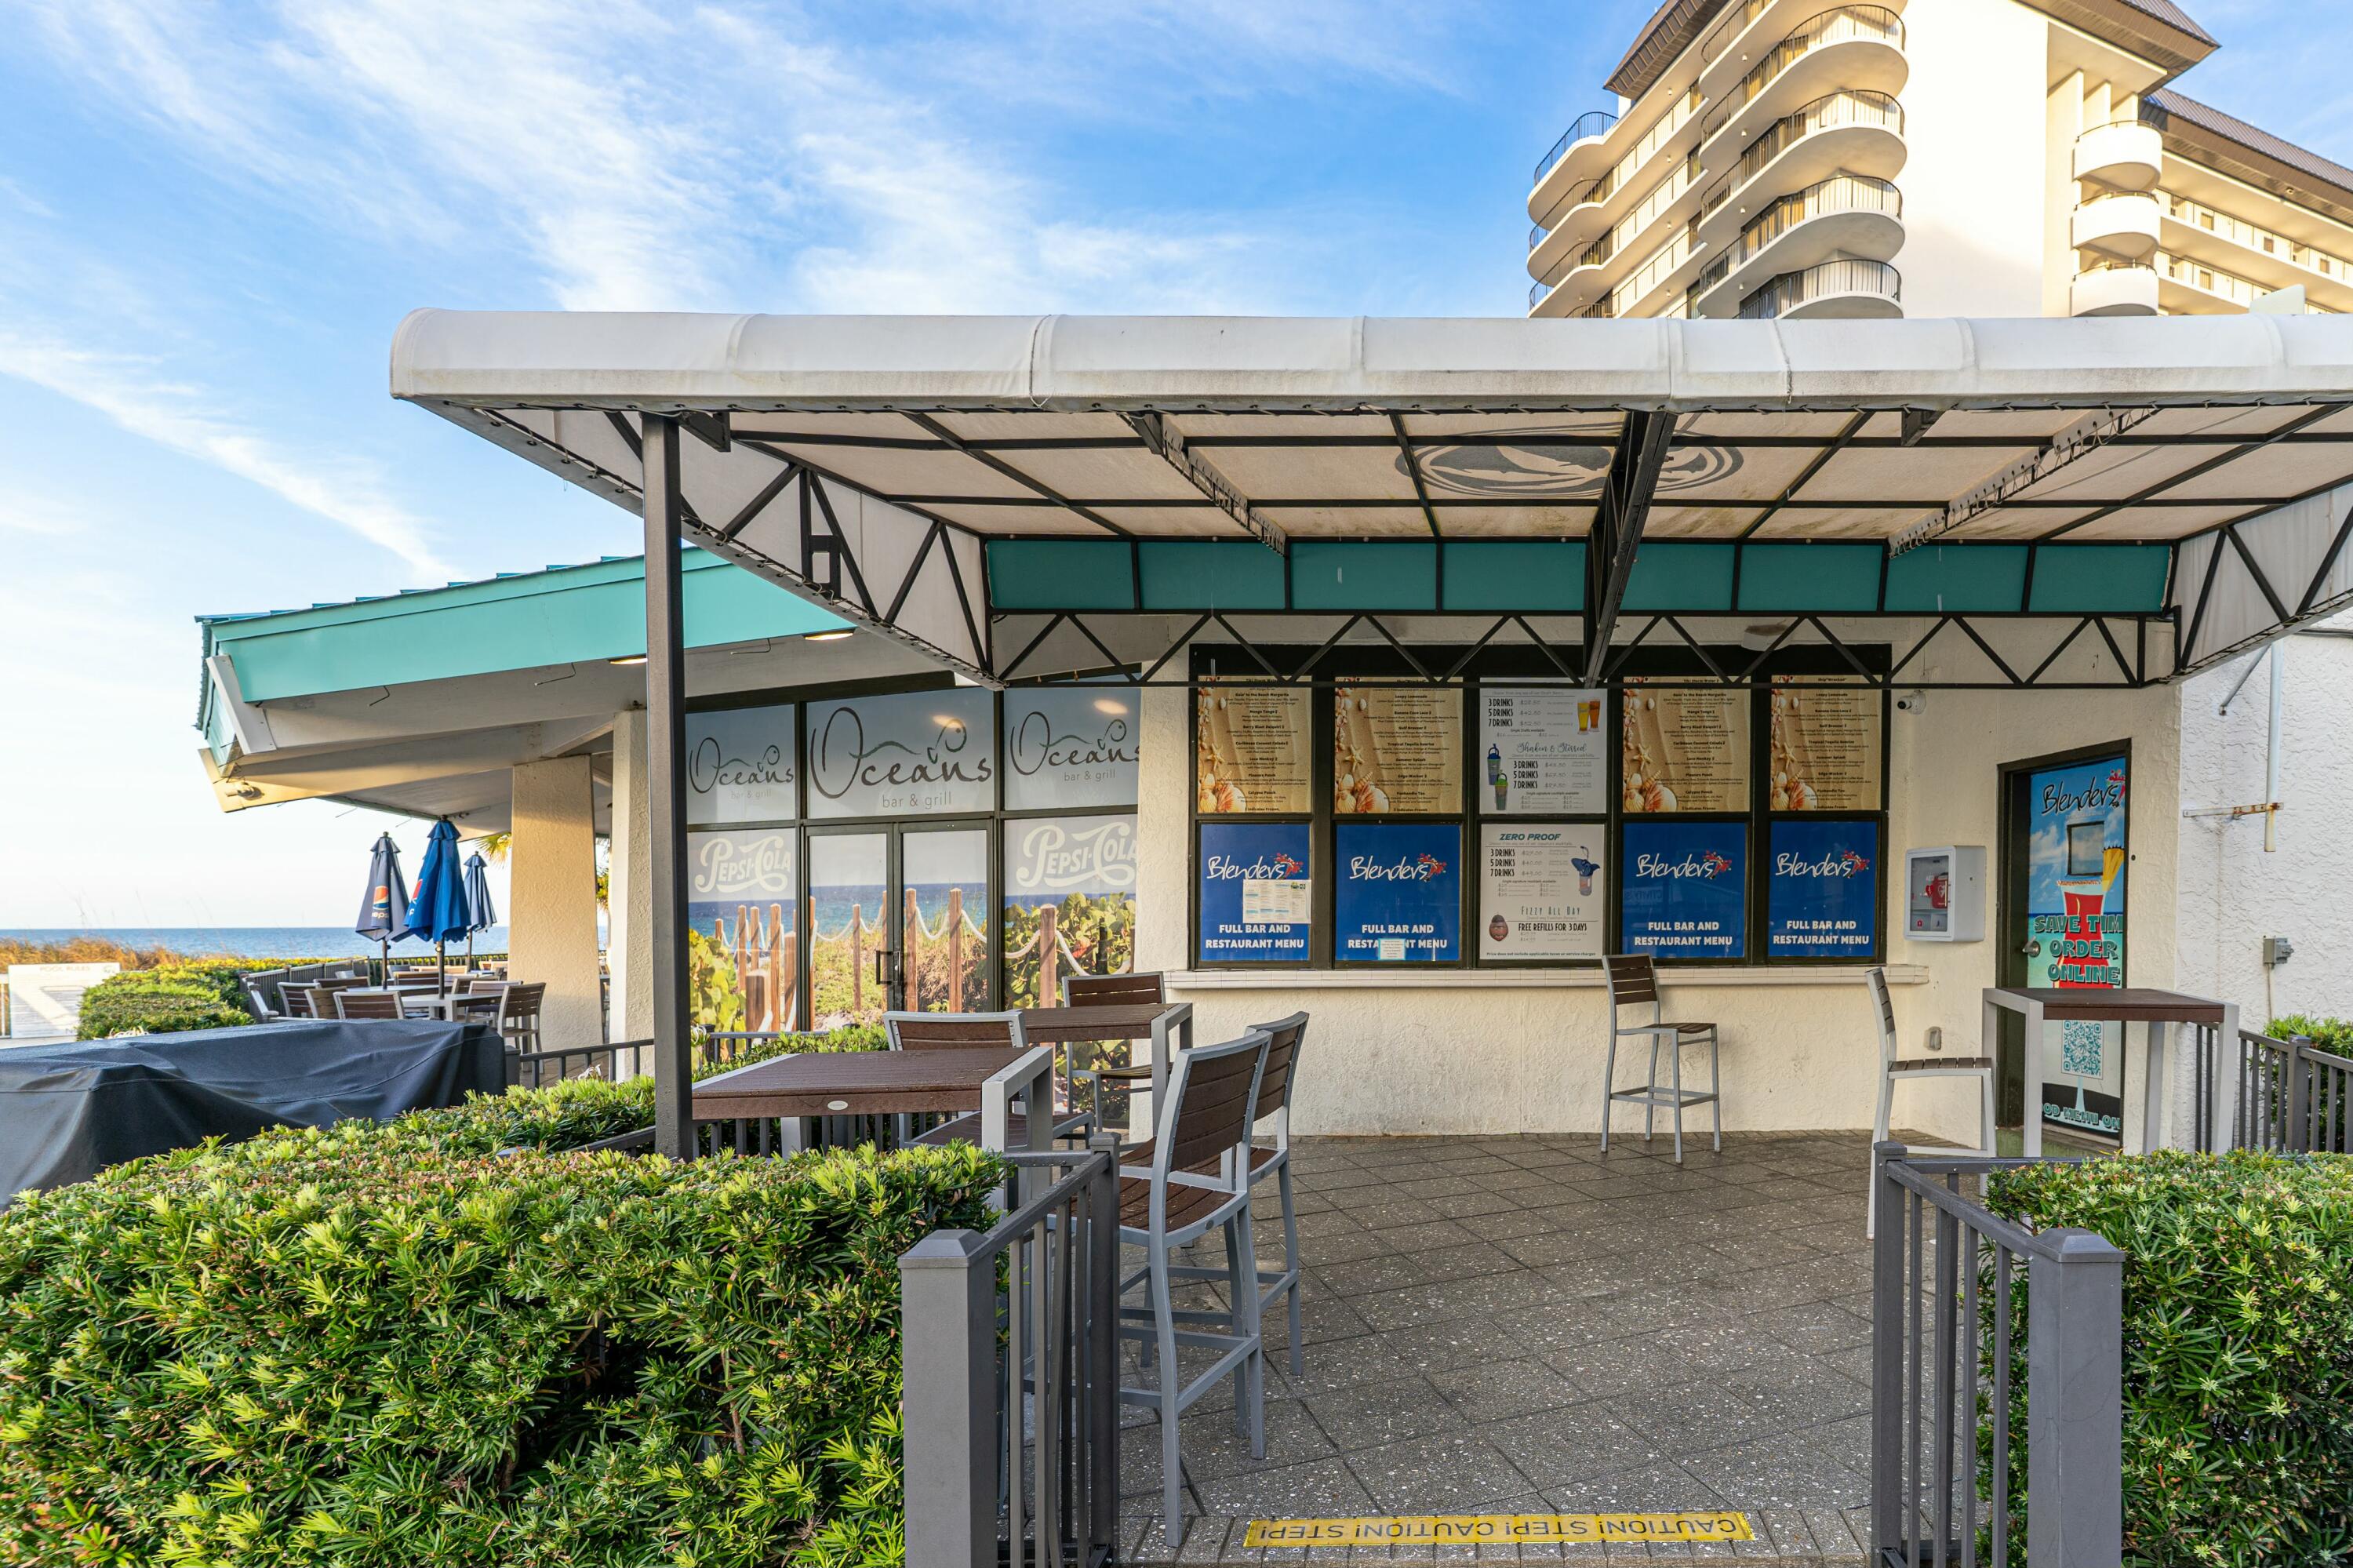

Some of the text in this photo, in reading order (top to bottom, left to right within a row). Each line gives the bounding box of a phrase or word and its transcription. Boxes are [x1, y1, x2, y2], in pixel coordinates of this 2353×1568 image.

[810, 707, 991, 799] Oceans
[689, 737, 794, 793] Oceans
[1064, 769, 1115, 782] bar & grill
[882, 791, 951, 809] bar & grill
[2042, 777, 2118, 814] Blenders
[1207, 856, 1284, 880] Blenders
[1350, 856, 1427, 880] Blenders
[1636, 853, 1712, 879] Blenders
[1776, 853, 1851, 879] Blenders
[1220, 925, 1290, 933] FULL BAR AND
[1362, 925, 1434, 933] FULL BAR AND
[1648, 922, 1719, 931] FULL BAR AND
[1787, 920, 1856, 930] FULL BAR AND
[2035, 915, 2123, 933] SAVE TIM
[1206, 939, 1304, 948] RESTAURANT MENU
[1348, 939, 1447, 948] RESTANT MENU
[1635, 937, 1732, 946] RESTAURANT MENU
[1773, 935, 1869, 944] RESTAURANT MENU
[2049, 940, 2118, 960] ORDER
[2048, 964, 2120, 985] ONLINE
[2063, 1107, 2100, 1126] MENU
[1260, 1519, 1737, 1539] CAUTION! STEP! CAUTION! STEP!
